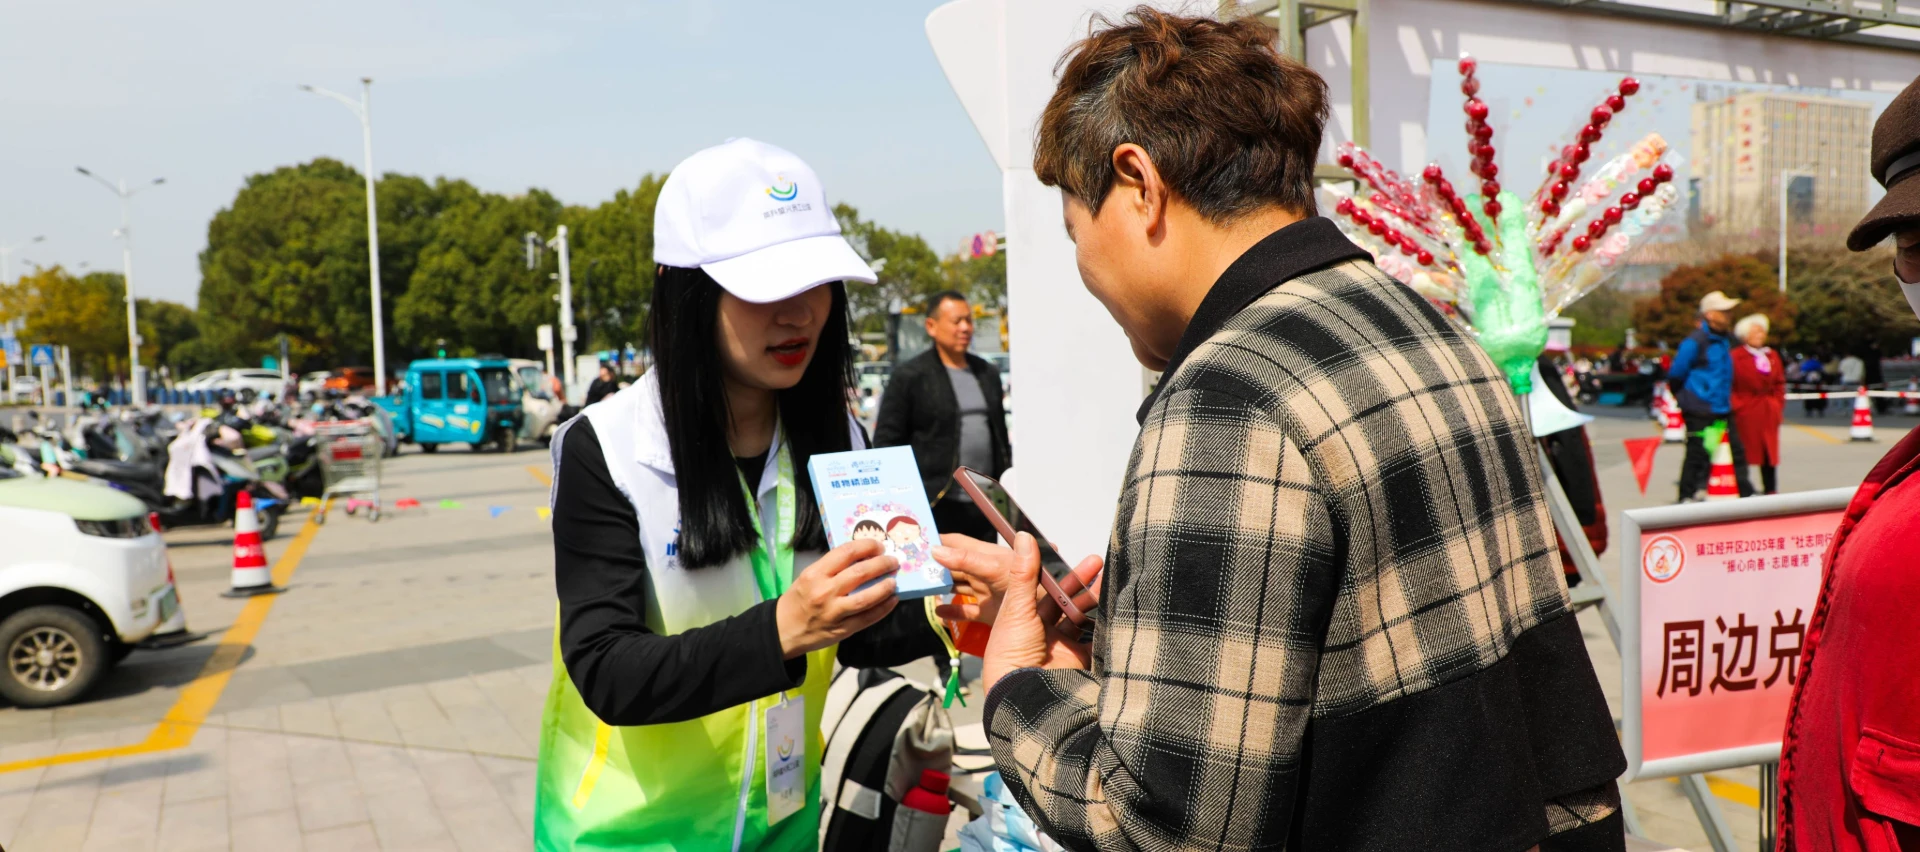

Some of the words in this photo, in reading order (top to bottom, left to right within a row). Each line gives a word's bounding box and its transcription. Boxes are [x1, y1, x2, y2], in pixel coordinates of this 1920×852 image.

[831, 476, 880, 489] 植物精油贴
[1656, 608, 1806, 700] 周边兑
